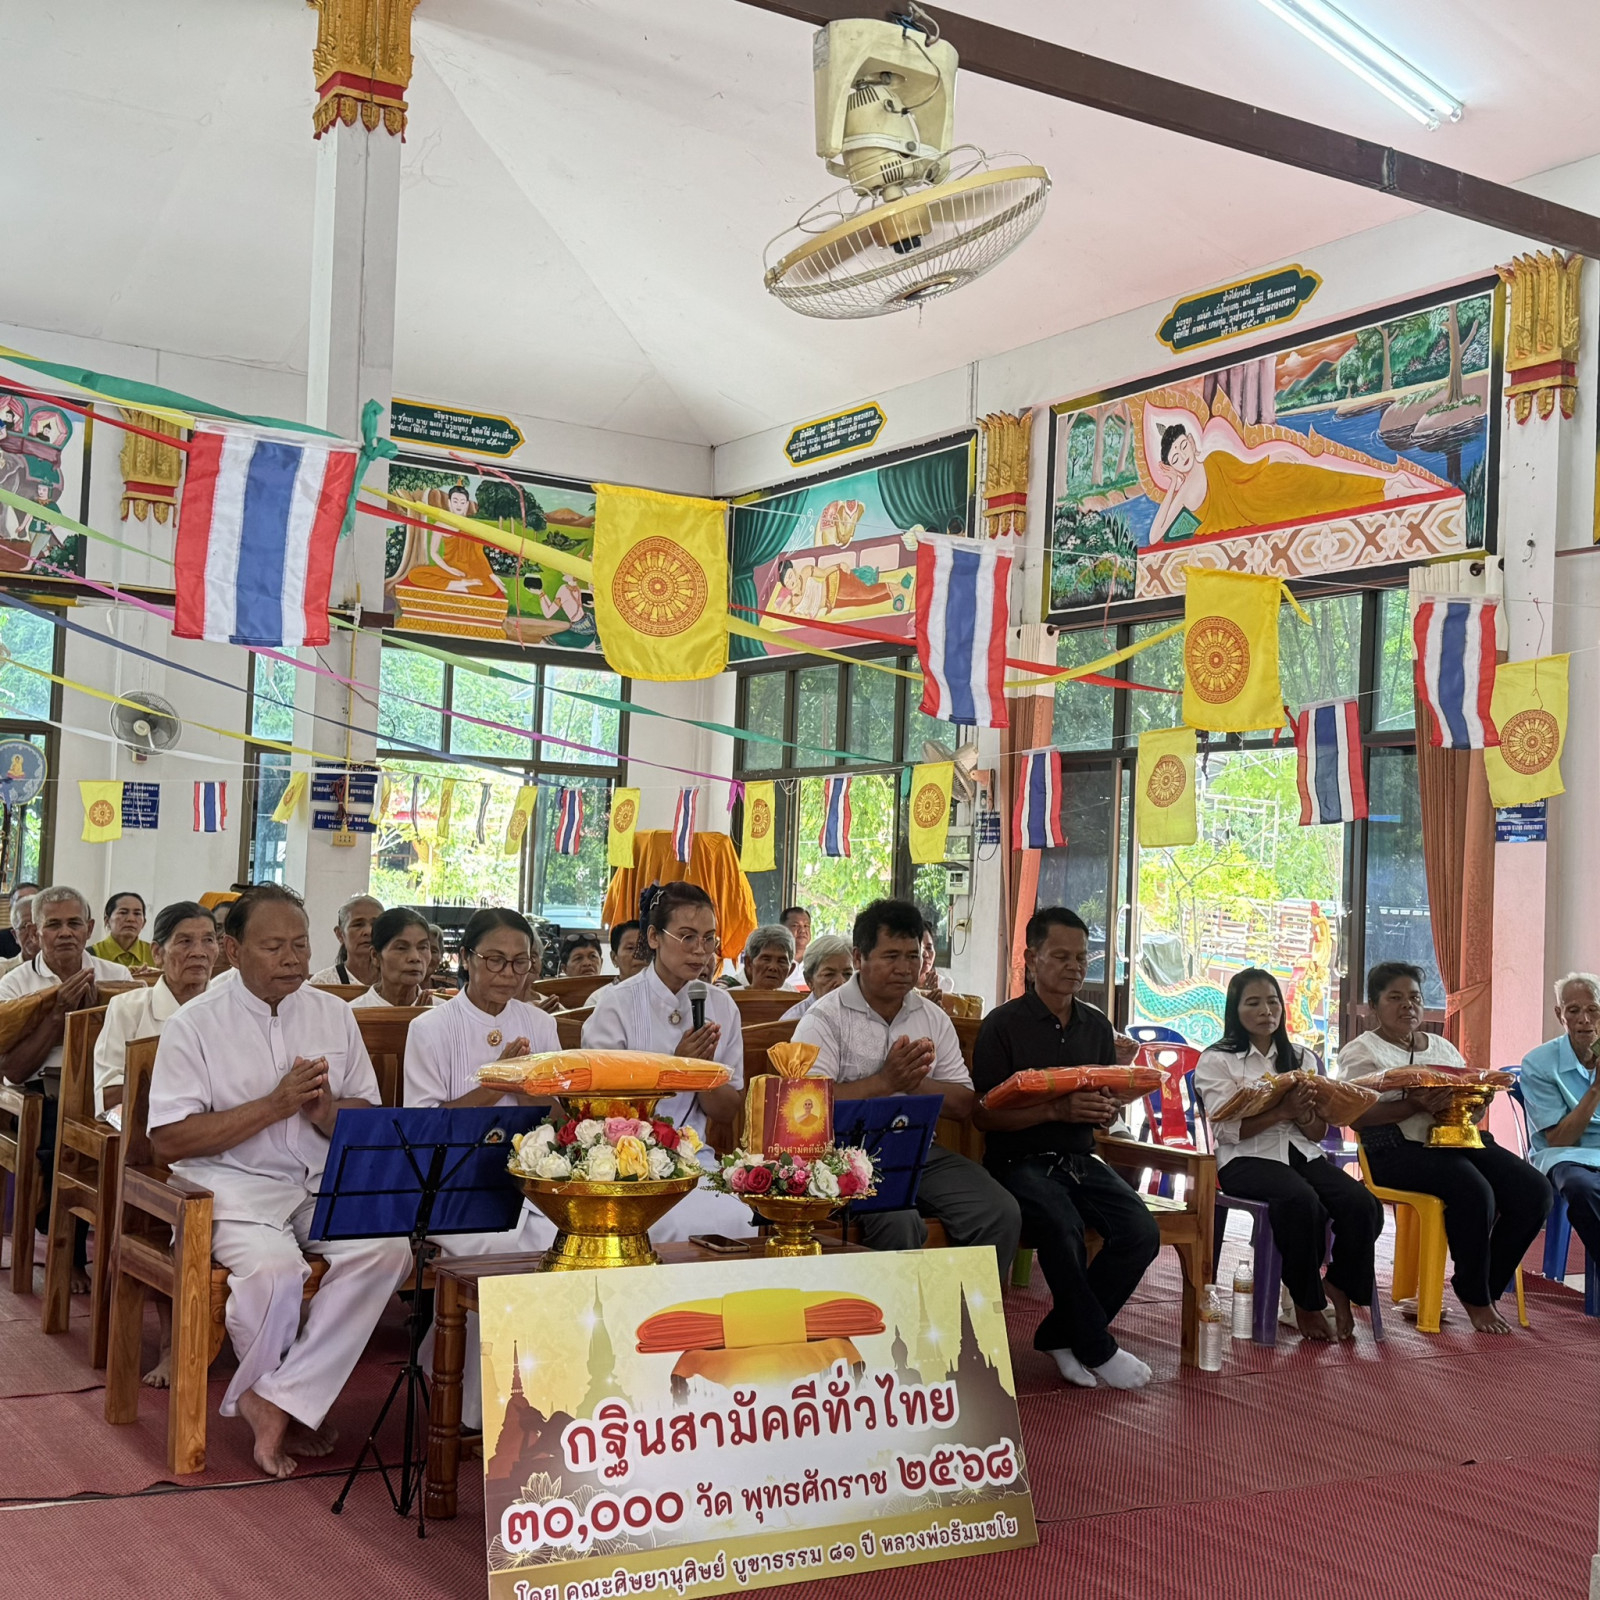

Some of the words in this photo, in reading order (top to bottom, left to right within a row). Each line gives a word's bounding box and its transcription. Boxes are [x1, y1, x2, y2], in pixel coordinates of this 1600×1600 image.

[566, 1366, 956, 1478] กฐินสามัคคีทั่วไทย
[507, 1491, 685, 1546] ๓๐,๐๐๐
[696, 1483, 733, 1517] วัด
[741, 1469, 888, 1524] พุทธศักราช
[898, 1444, 1014, 1486] ๒๕๖๘
[567, 1555, 726, 1600] คณะศิษยานุศิษย์
[733, 1547, 822, 1581] บูชาธรรม
[829, 1544, 856, 1561] ๘๑
[862, 1533, 875, 1556] ปี
[882, 1516, 1018, 1553] หลวงพ่อธัมมชโย
